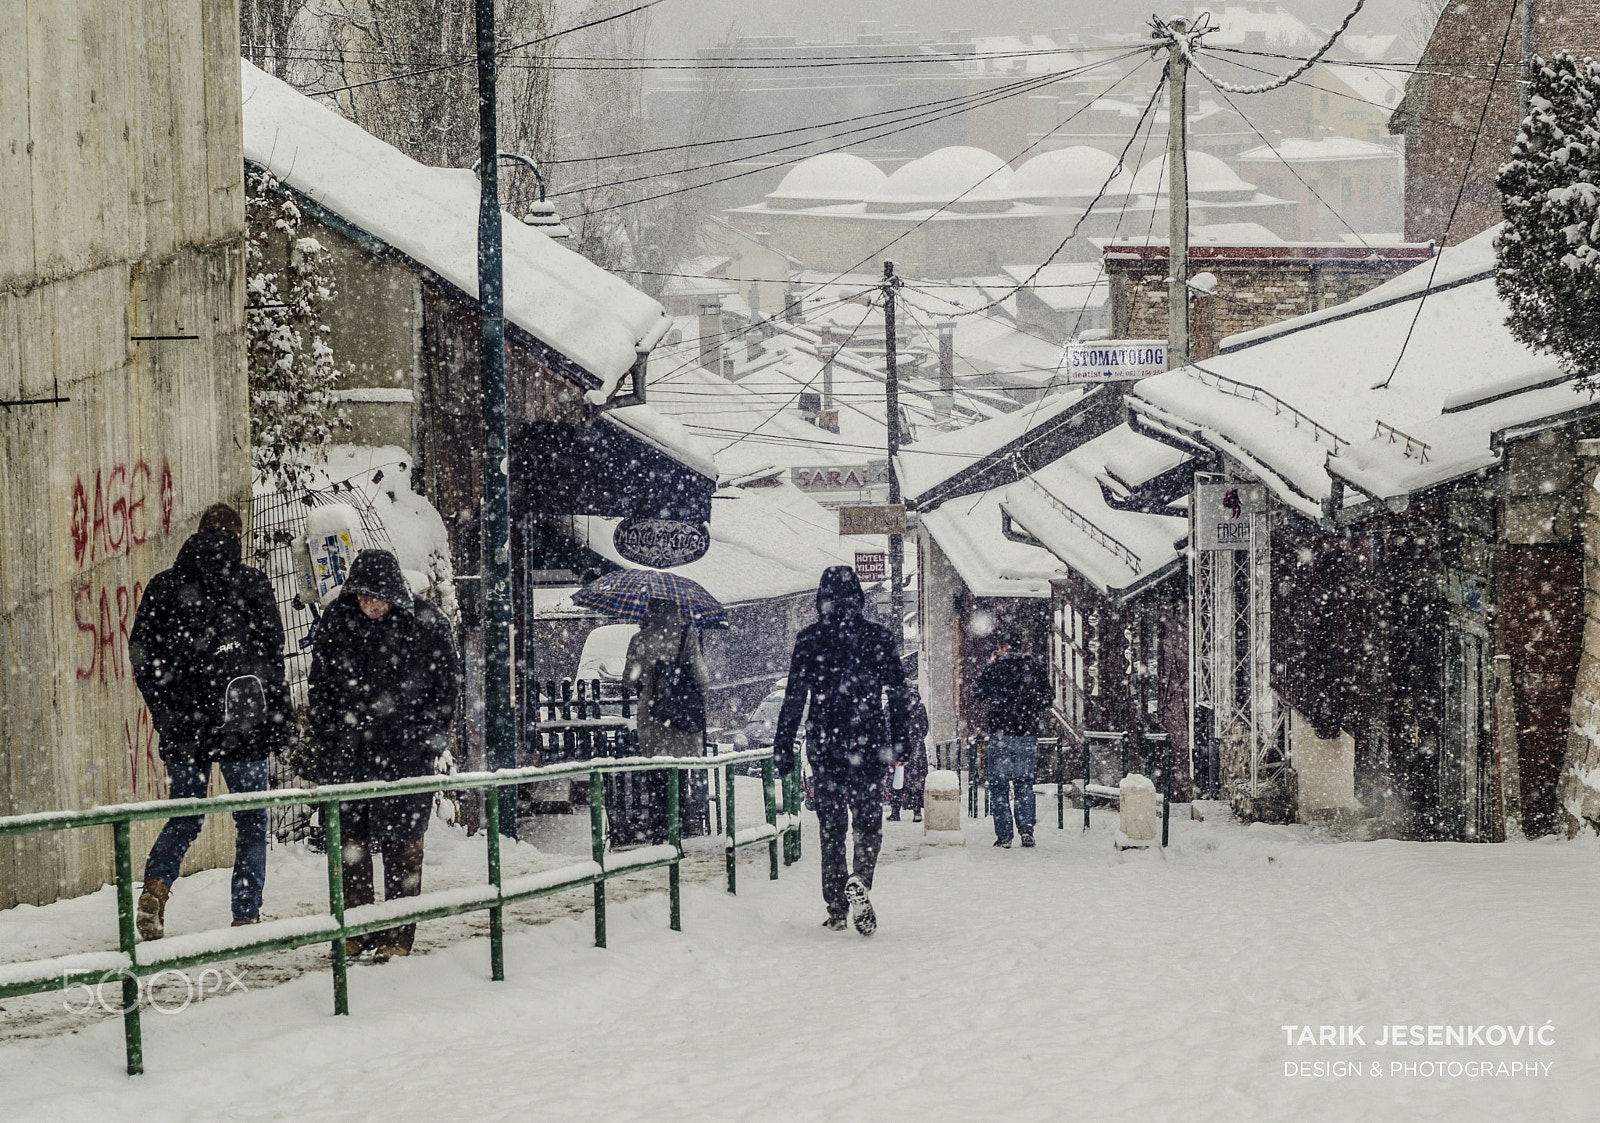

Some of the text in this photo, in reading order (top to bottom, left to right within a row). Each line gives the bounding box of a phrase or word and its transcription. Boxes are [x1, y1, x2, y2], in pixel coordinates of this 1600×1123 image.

[1072, 348, 1163, 367] STOMATOLOG
[1072, 370, 1102, 379] dentist
[617, 527, 706, 551] MANUFAKTURA
[856, 554, 885, 562] HOTEL
[856, 563, 884, 572] YILDIZ
